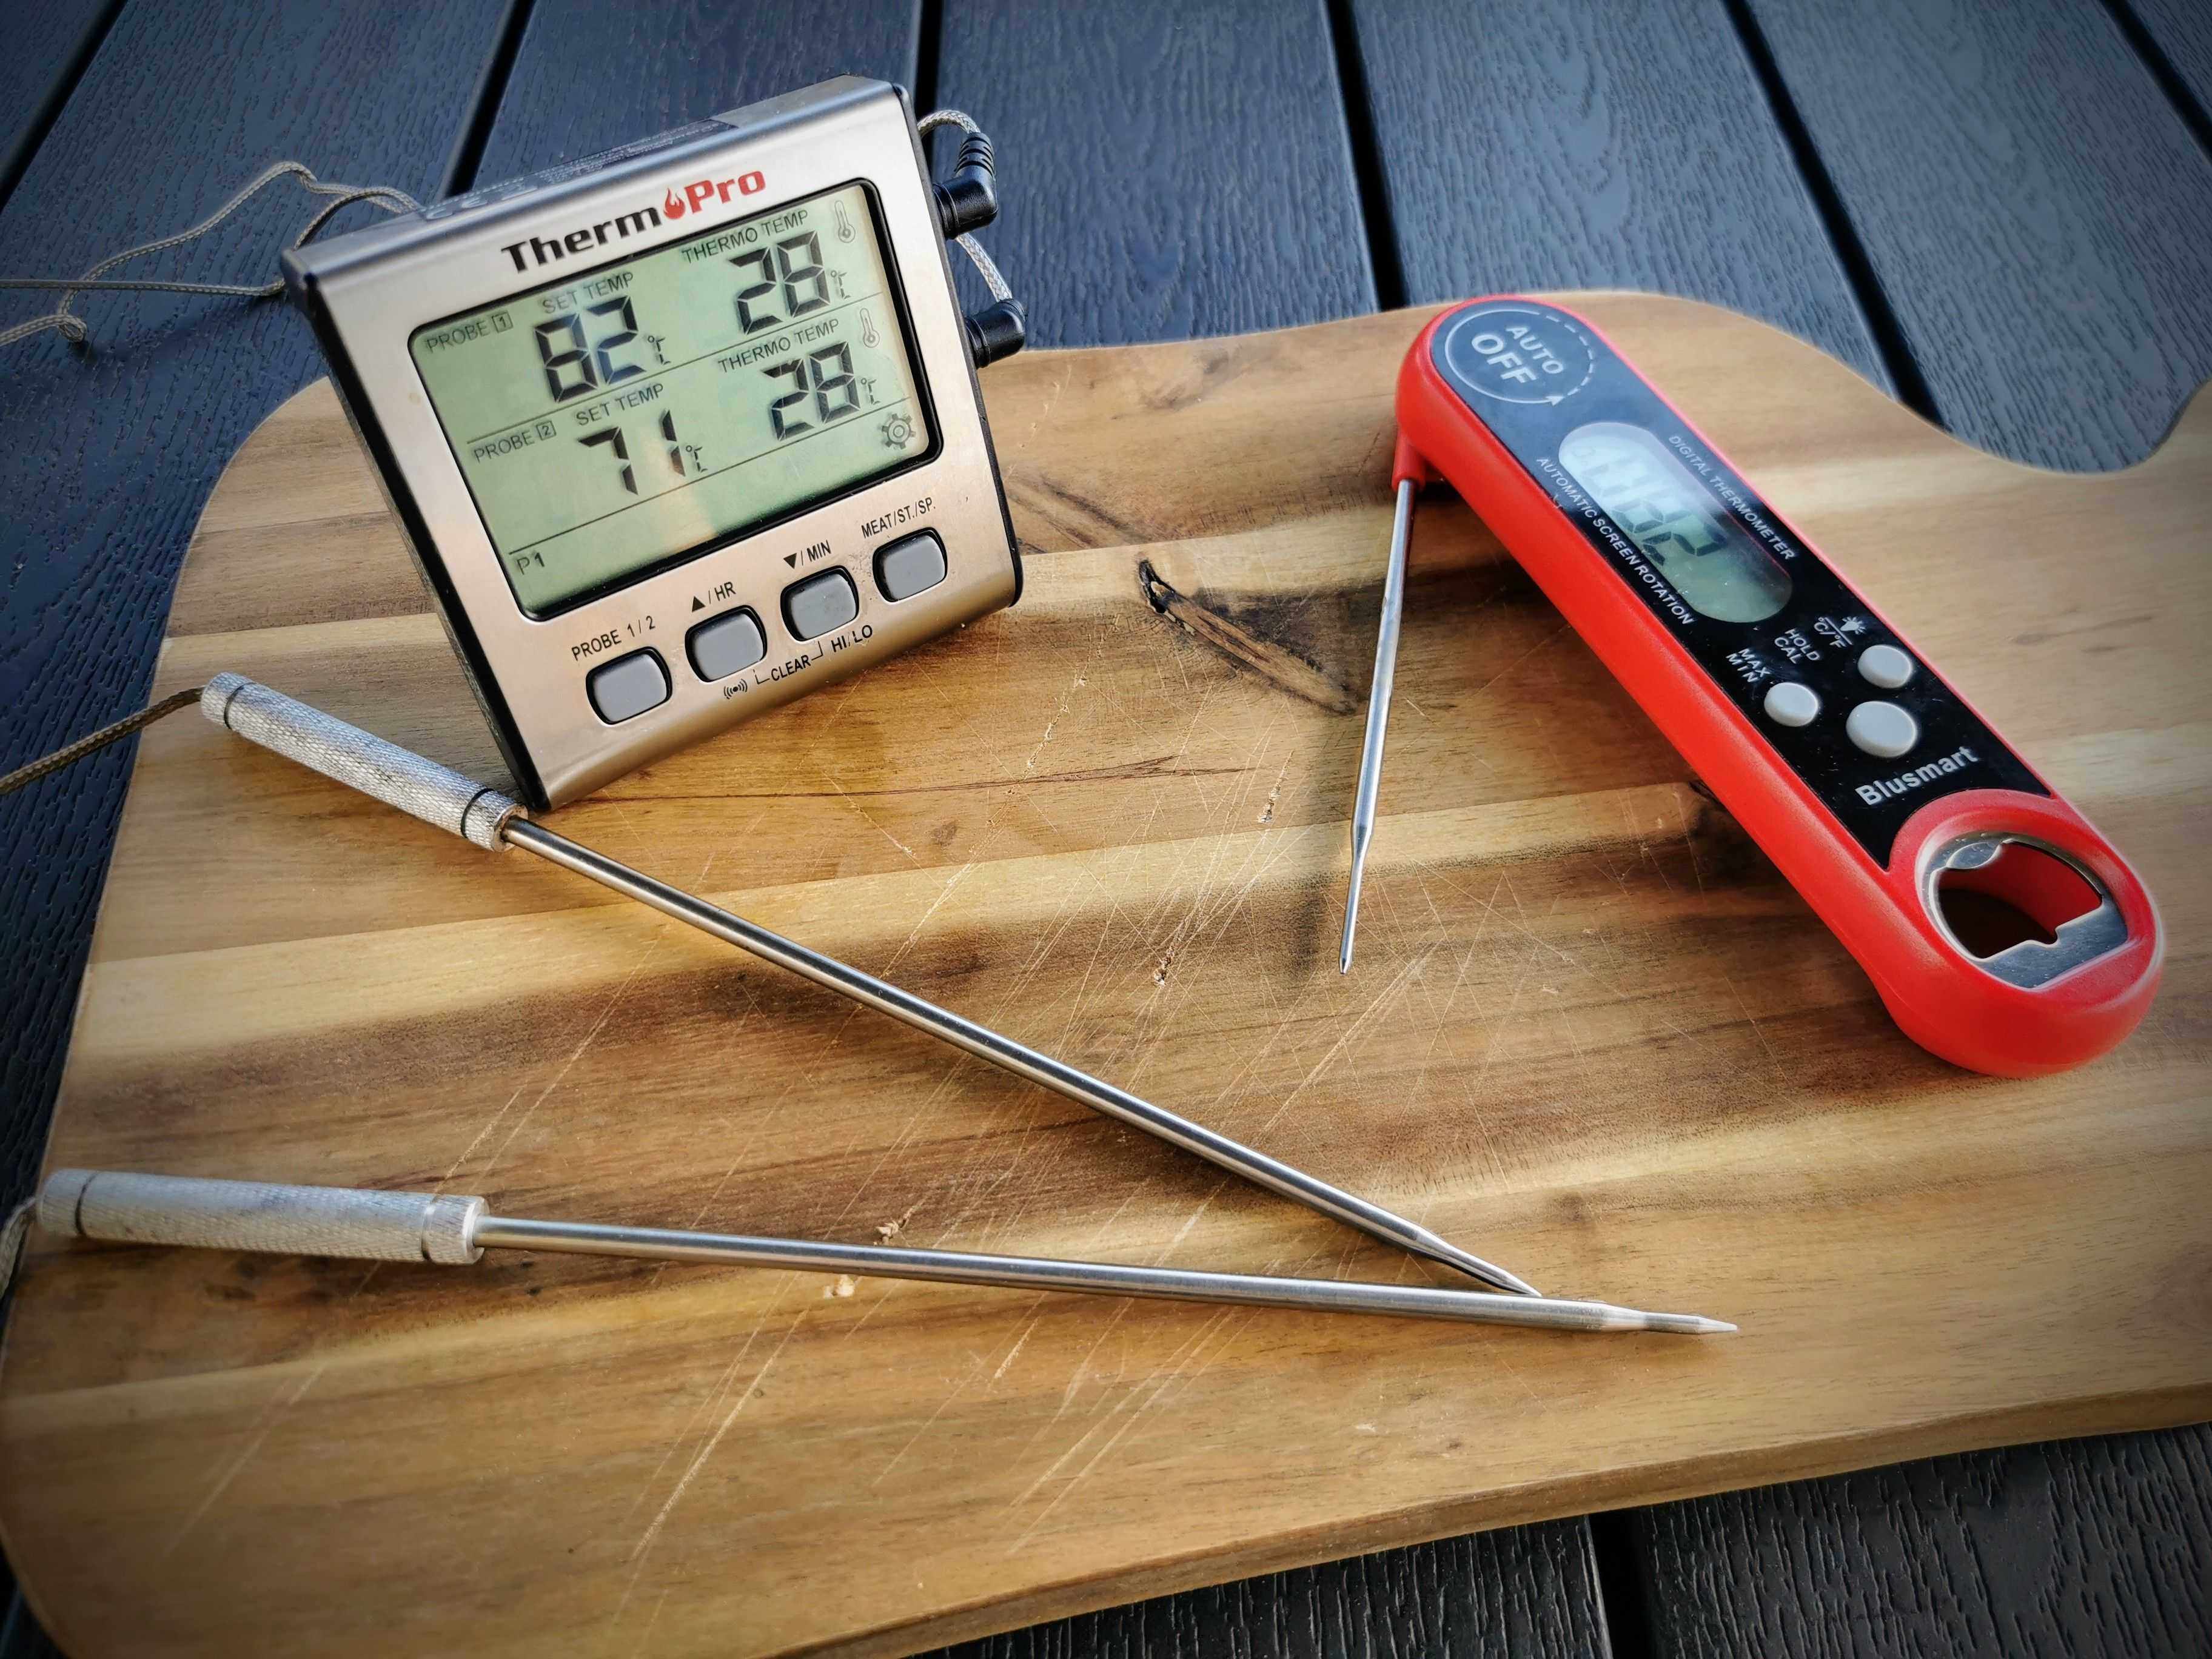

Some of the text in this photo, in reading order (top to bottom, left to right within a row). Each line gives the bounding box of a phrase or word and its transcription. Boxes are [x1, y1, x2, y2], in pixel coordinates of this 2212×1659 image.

[682, 210, 809, 264] THERMO TEMP
[543, 272, 634, 314] SET TEMP
[729, 230, 831, 335] 28
[426, 320, 490, 354] PROBE
[534, 295, 647, 403] 82
[718, 319, 839, 374] THERMO TEMP
[1472, 333, 1537, 383] OFF
[1506, 326, 1564, 374] AUTO
[575, 383, 665, 426] SET TEMP
[762, 340, 861, 441] 28
[472, 434, 536, 463] PROBE
[577, 410, 686, 495] 71
[1668, 435, 1797, 560] DIGITAL THERMOMETER
[516, 552, 546, 575] P1
[1536, 457, 1696, 625] AUTOMATIC SCREEN ROTATION
[571, 629, 621, 662] PROBE
[1738, 648, 1771, 677] MAX
[1774, 637, 1801, 664] CAL
[1785, 628, 1820, 661] HOLD
[771, 654, 811, 682] CLEAR
[1726, 653, 1759, 683] MIN
[1855, 746, 1980, 806] Blusmart
